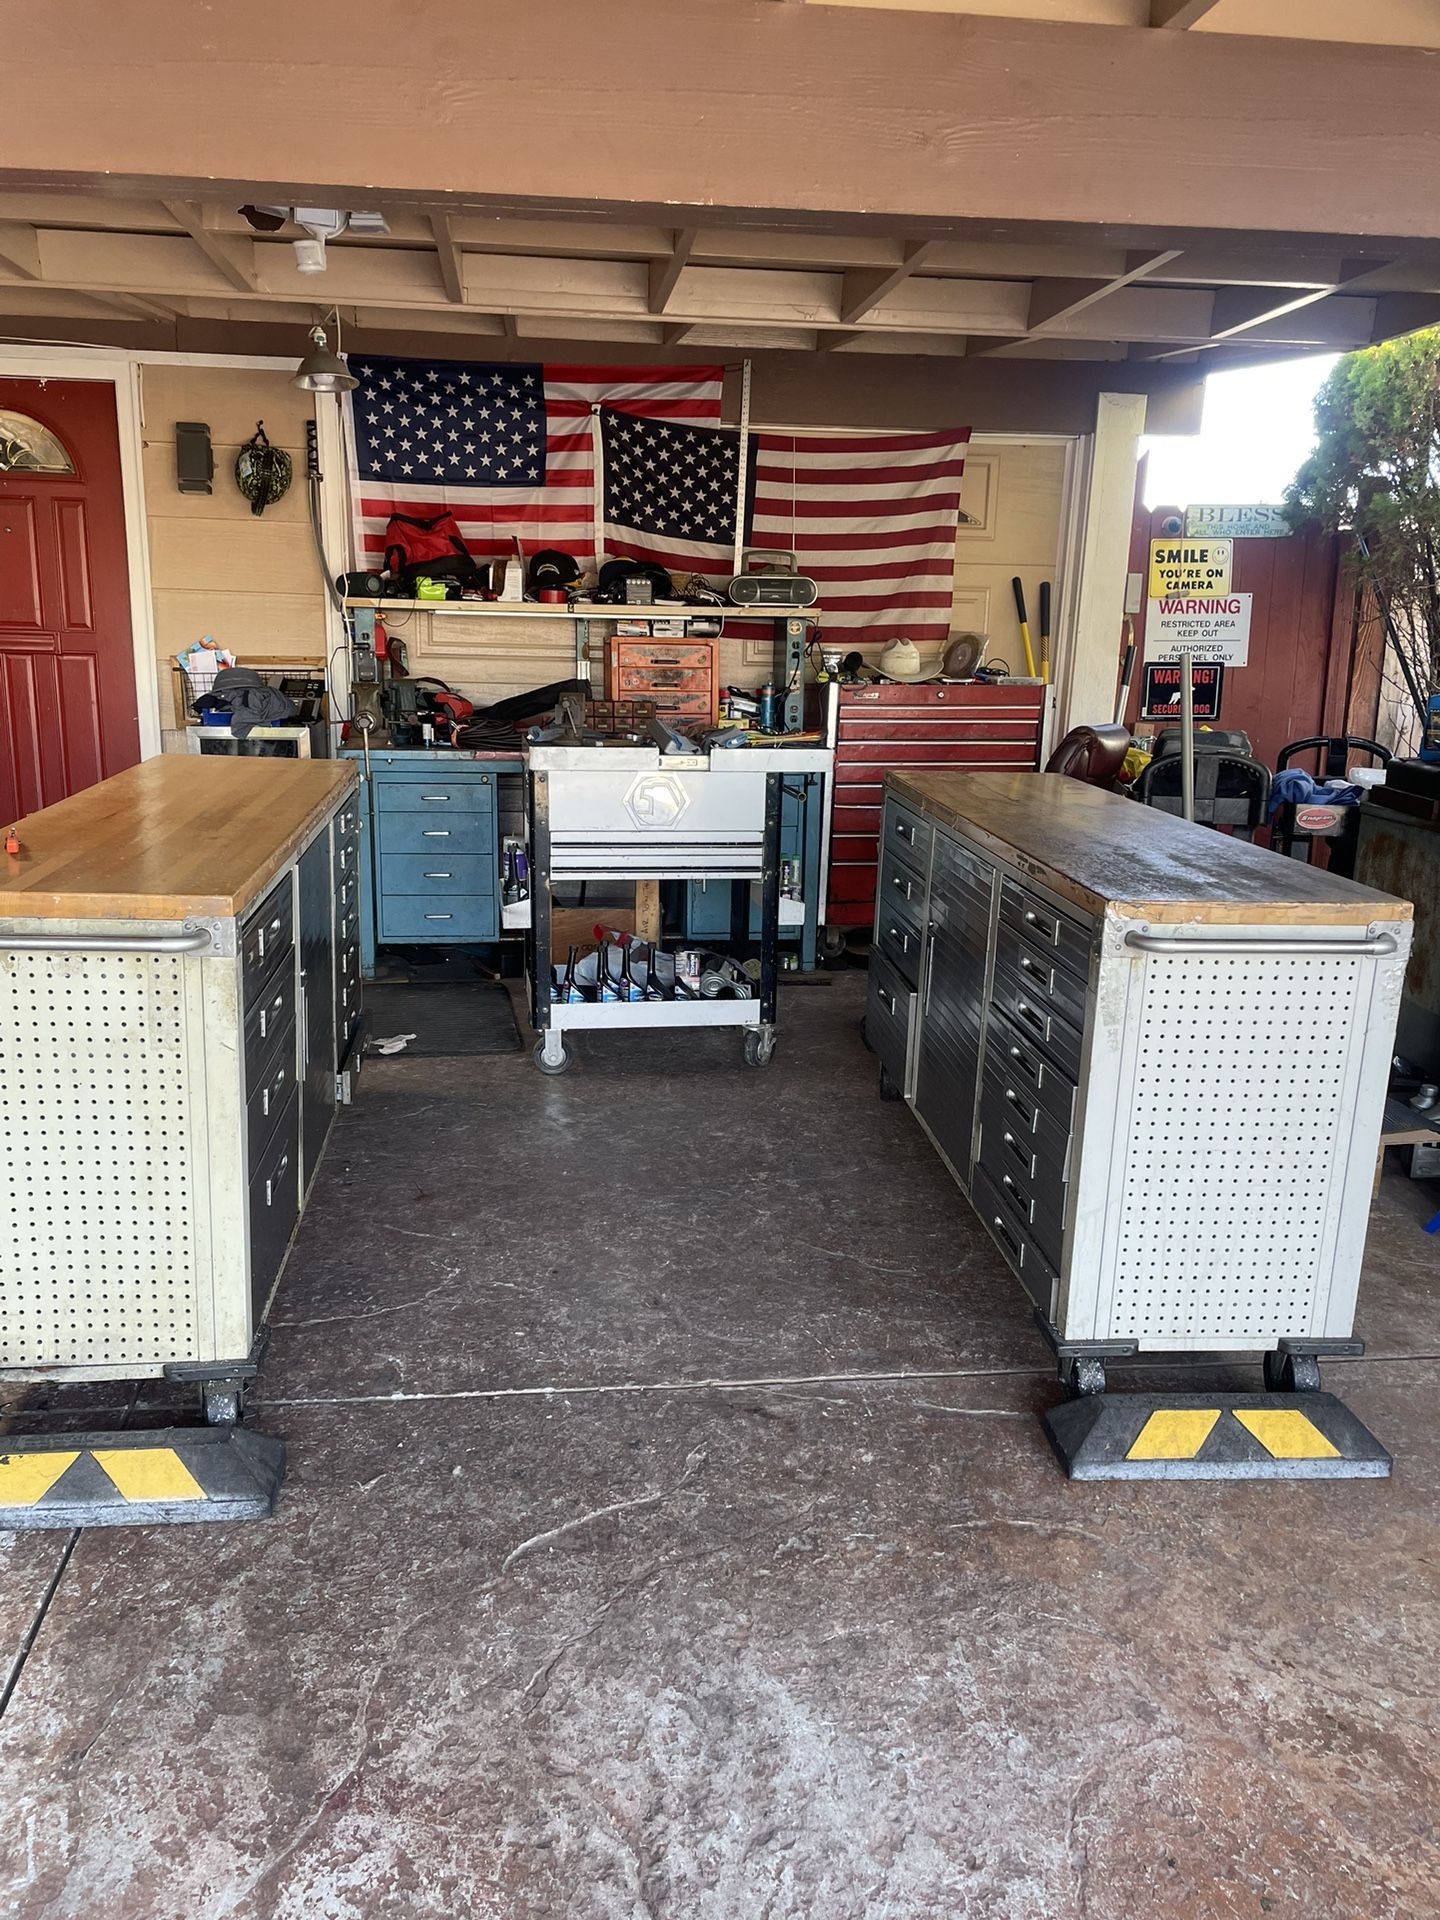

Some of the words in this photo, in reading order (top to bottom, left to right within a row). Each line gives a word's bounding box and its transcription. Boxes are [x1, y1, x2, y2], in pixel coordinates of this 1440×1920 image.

[1198, 507, 1285, 522] BLESS
[1155, 549, 1209, 564] SMILE
[1159, 569, 1202, 579] YOU'RE
[1206, 569, 1223, 578] ON
[1166, 581, 1213, 590] CAMERA
[1158, 599, 1241, 615] WARNING
[1160, 620, 1211, 628] RESTRICTED
[1214, 620, 1236, 628] AREA
[1177, 629, 1199, 637] KEEP
[1202, 629, 1219, 637] OUT
[1158, 653, 1209, 661] PERSNEL
[1212, 653, 1235, 661] ONLY
[1154, 669, 1215, 684] WARNG!
[1152, 704, 1187, 714] SECURI
[1193, 704, 1210, 714] DOG
